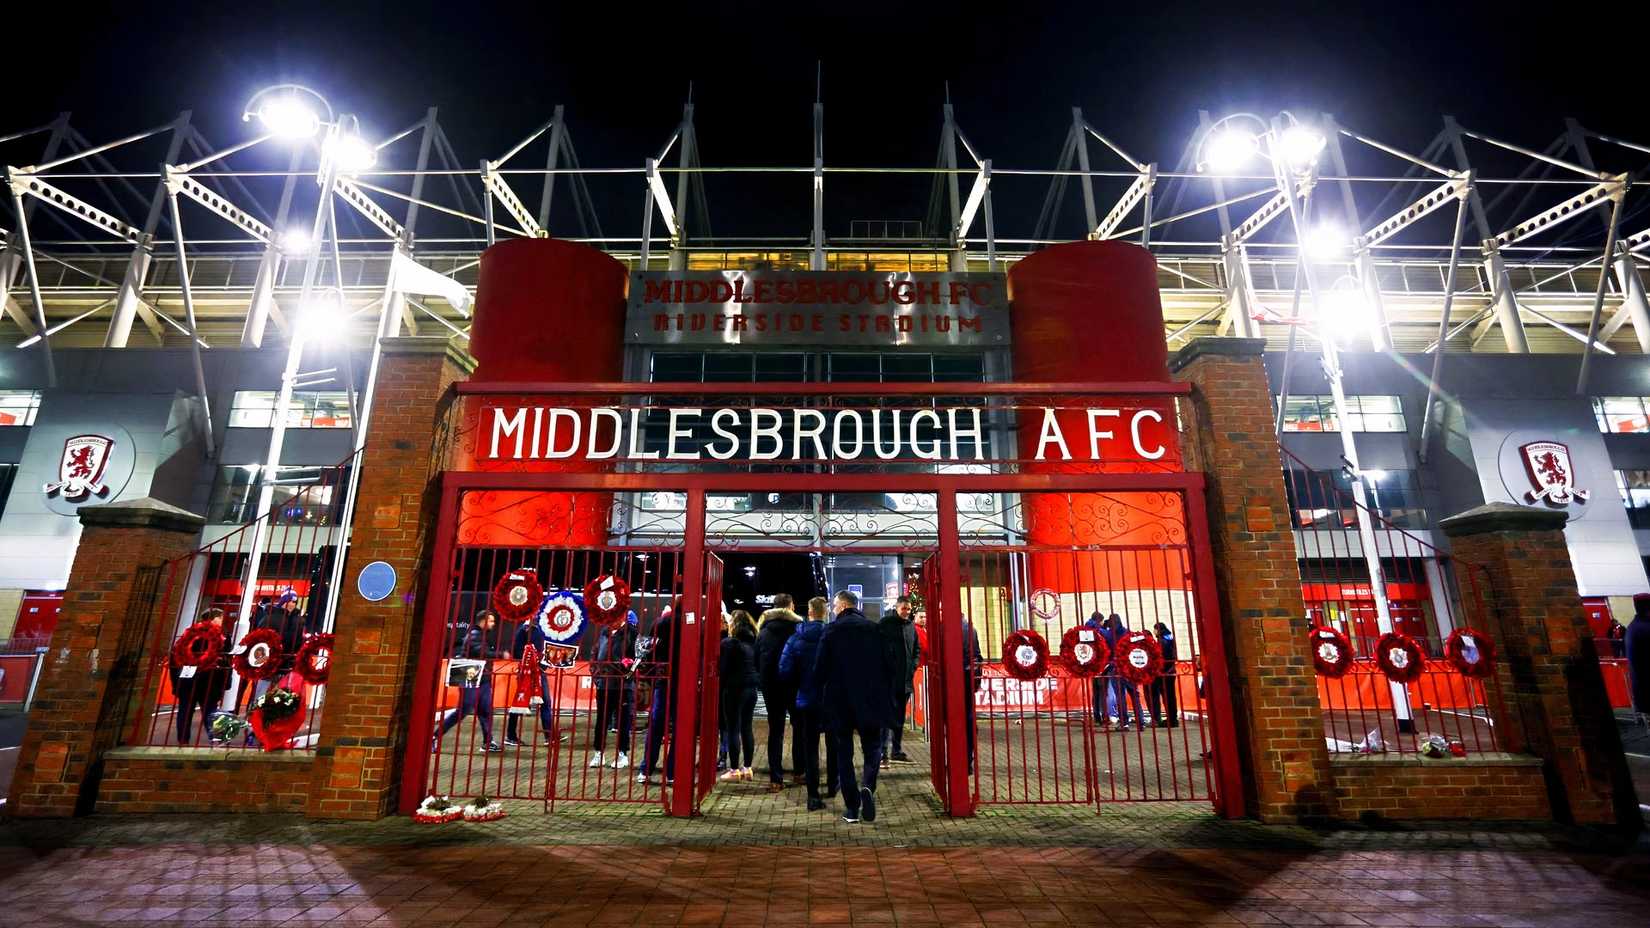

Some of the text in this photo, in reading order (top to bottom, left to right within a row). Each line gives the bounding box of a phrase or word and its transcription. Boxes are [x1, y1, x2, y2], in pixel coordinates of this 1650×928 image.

[643, 279, 993, 305] MIDDLESBROUGH FC
[654, 313, 983, 333] RIVERSIDE STADIUM
[488, 407, 1166, 460] MIDDLESBROUGH AFC
[974, 690, 1044, 705] TADIUM
